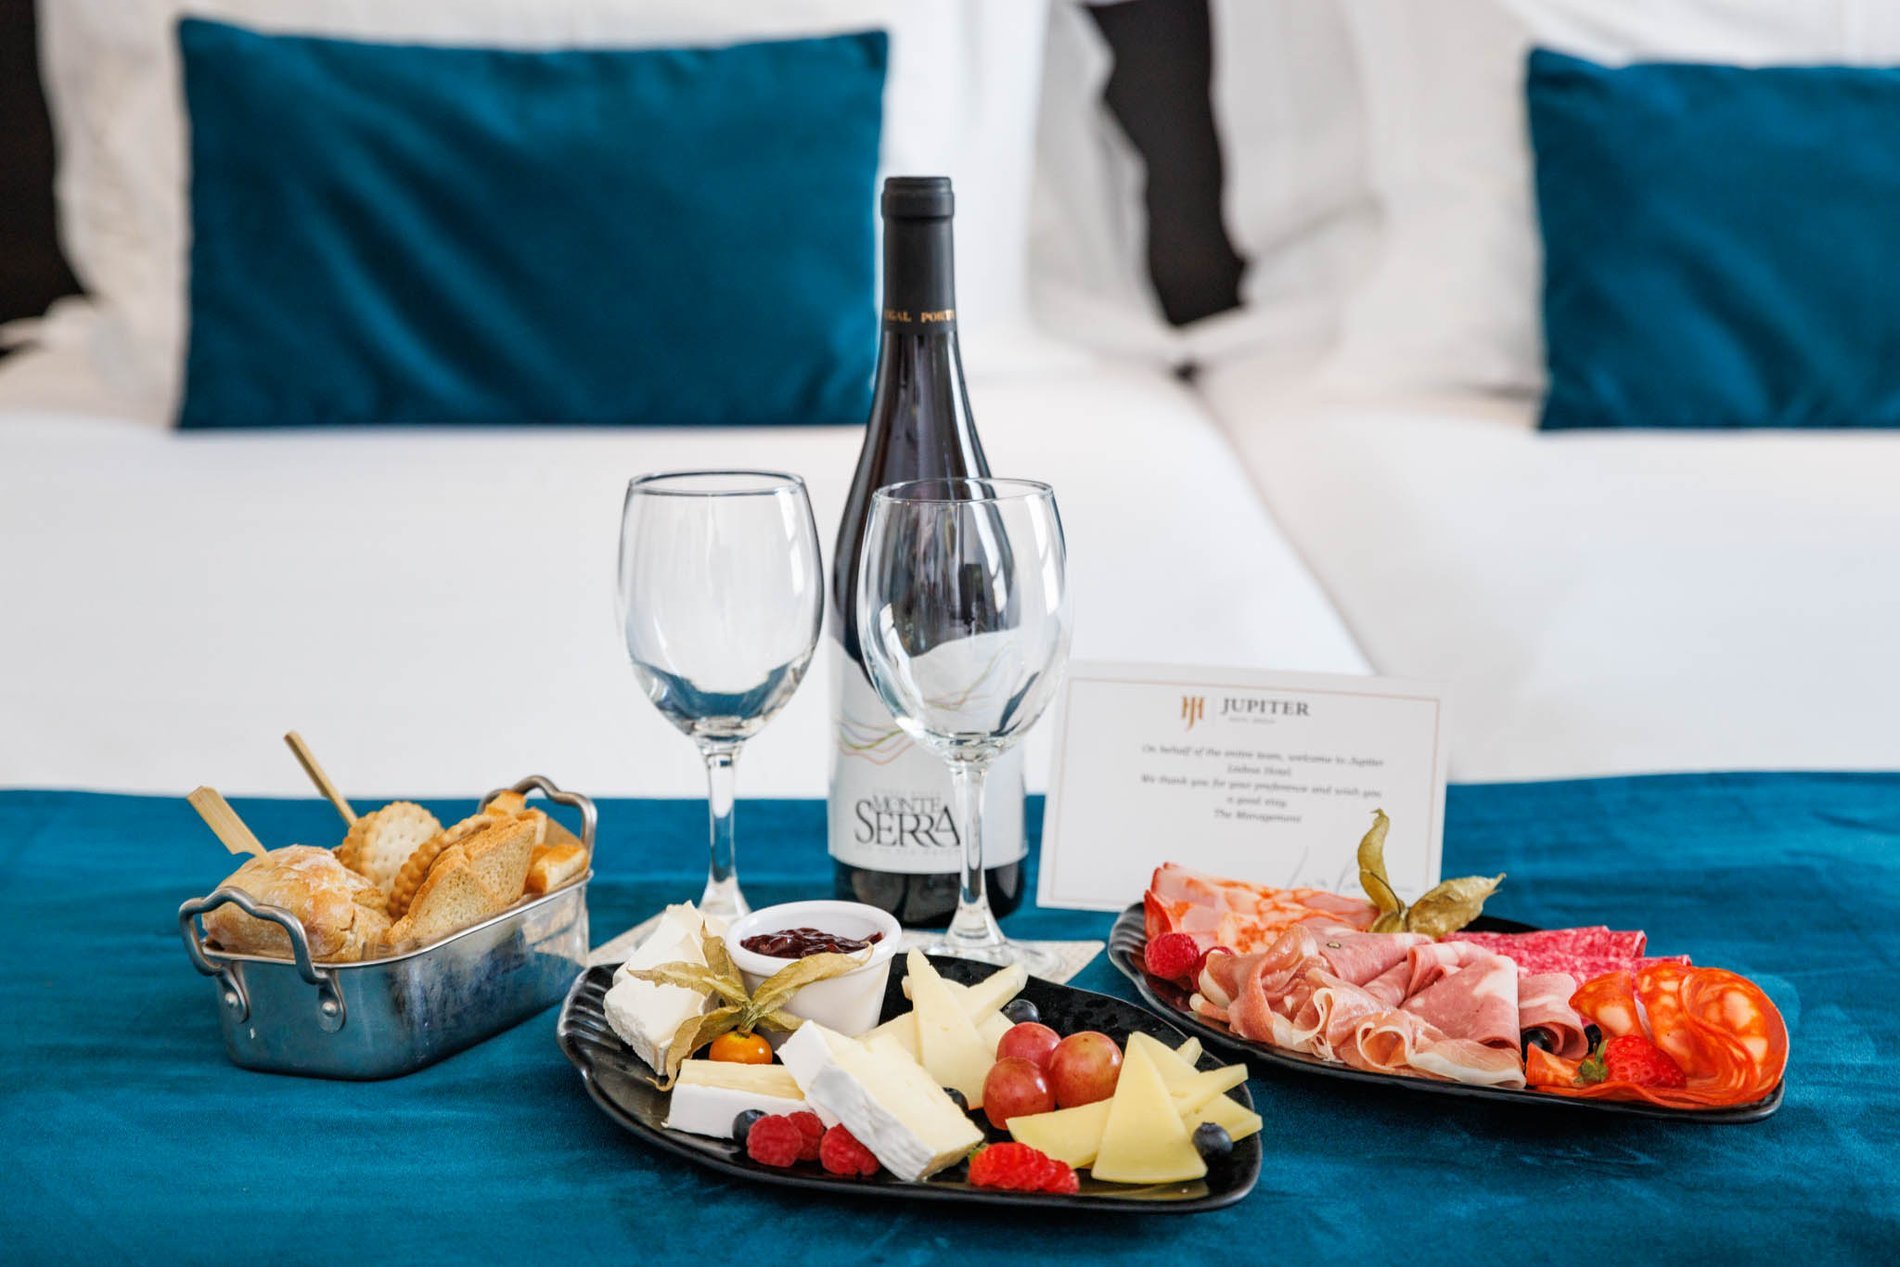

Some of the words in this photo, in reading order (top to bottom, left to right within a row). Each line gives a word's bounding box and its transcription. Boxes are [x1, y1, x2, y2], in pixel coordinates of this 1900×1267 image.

[1221, 698, 1311, 716] JUPITER
[1160, 745, 1192, 756] behalf
[1206, 748, 1221, 756] the
[1224, 750, 1254, 758] entire
[1288, 753, 1332, 763] welcome
[1348, 757, 1384, 768] Jupiter
[1141, 774, 1155, 782] We
[1159, 775, 1187, 785] thank
[1191, 779, 1209, 788] you
[1212, 778, 1226, 788] for
[1229, 782, 1251, 790] your
[1254, 782, 1308, 793] preference
[1311, 786, 1333, 795] and
[1335, 787, 1359, 796] wish
[872, 795, 943, 814] MONTE
[1237, 797, 1261, 806] good
[855, 800, 961, 847] SERRA
[1214, 808, 1232, 818] The
[1236, 811, 1302, 824] Management
